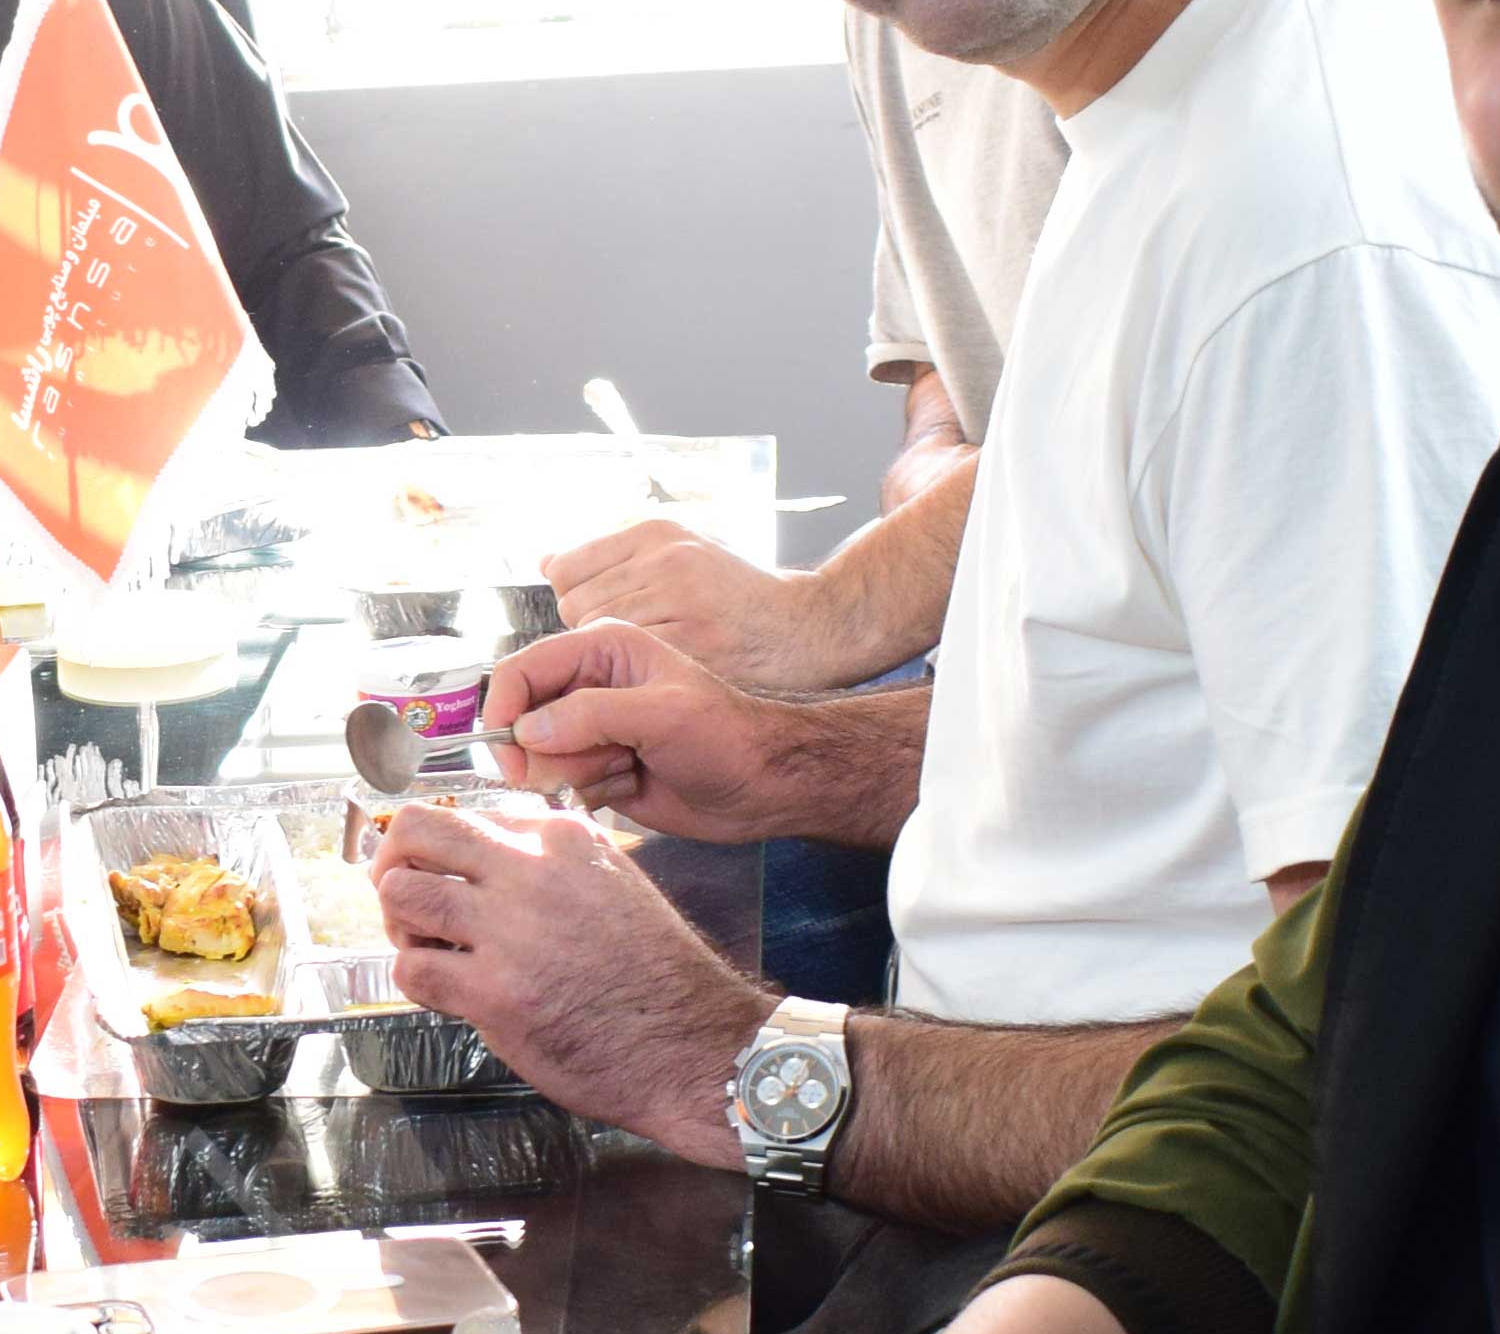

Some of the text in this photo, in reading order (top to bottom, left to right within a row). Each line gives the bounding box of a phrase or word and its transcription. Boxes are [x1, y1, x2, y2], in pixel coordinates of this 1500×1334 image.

[71, 198, 101, 252] مبلمان
[65, 250, 81, 266] و
[49, 260, 72, 311] صنایع
[39, 305, 62, 347] چوبی
